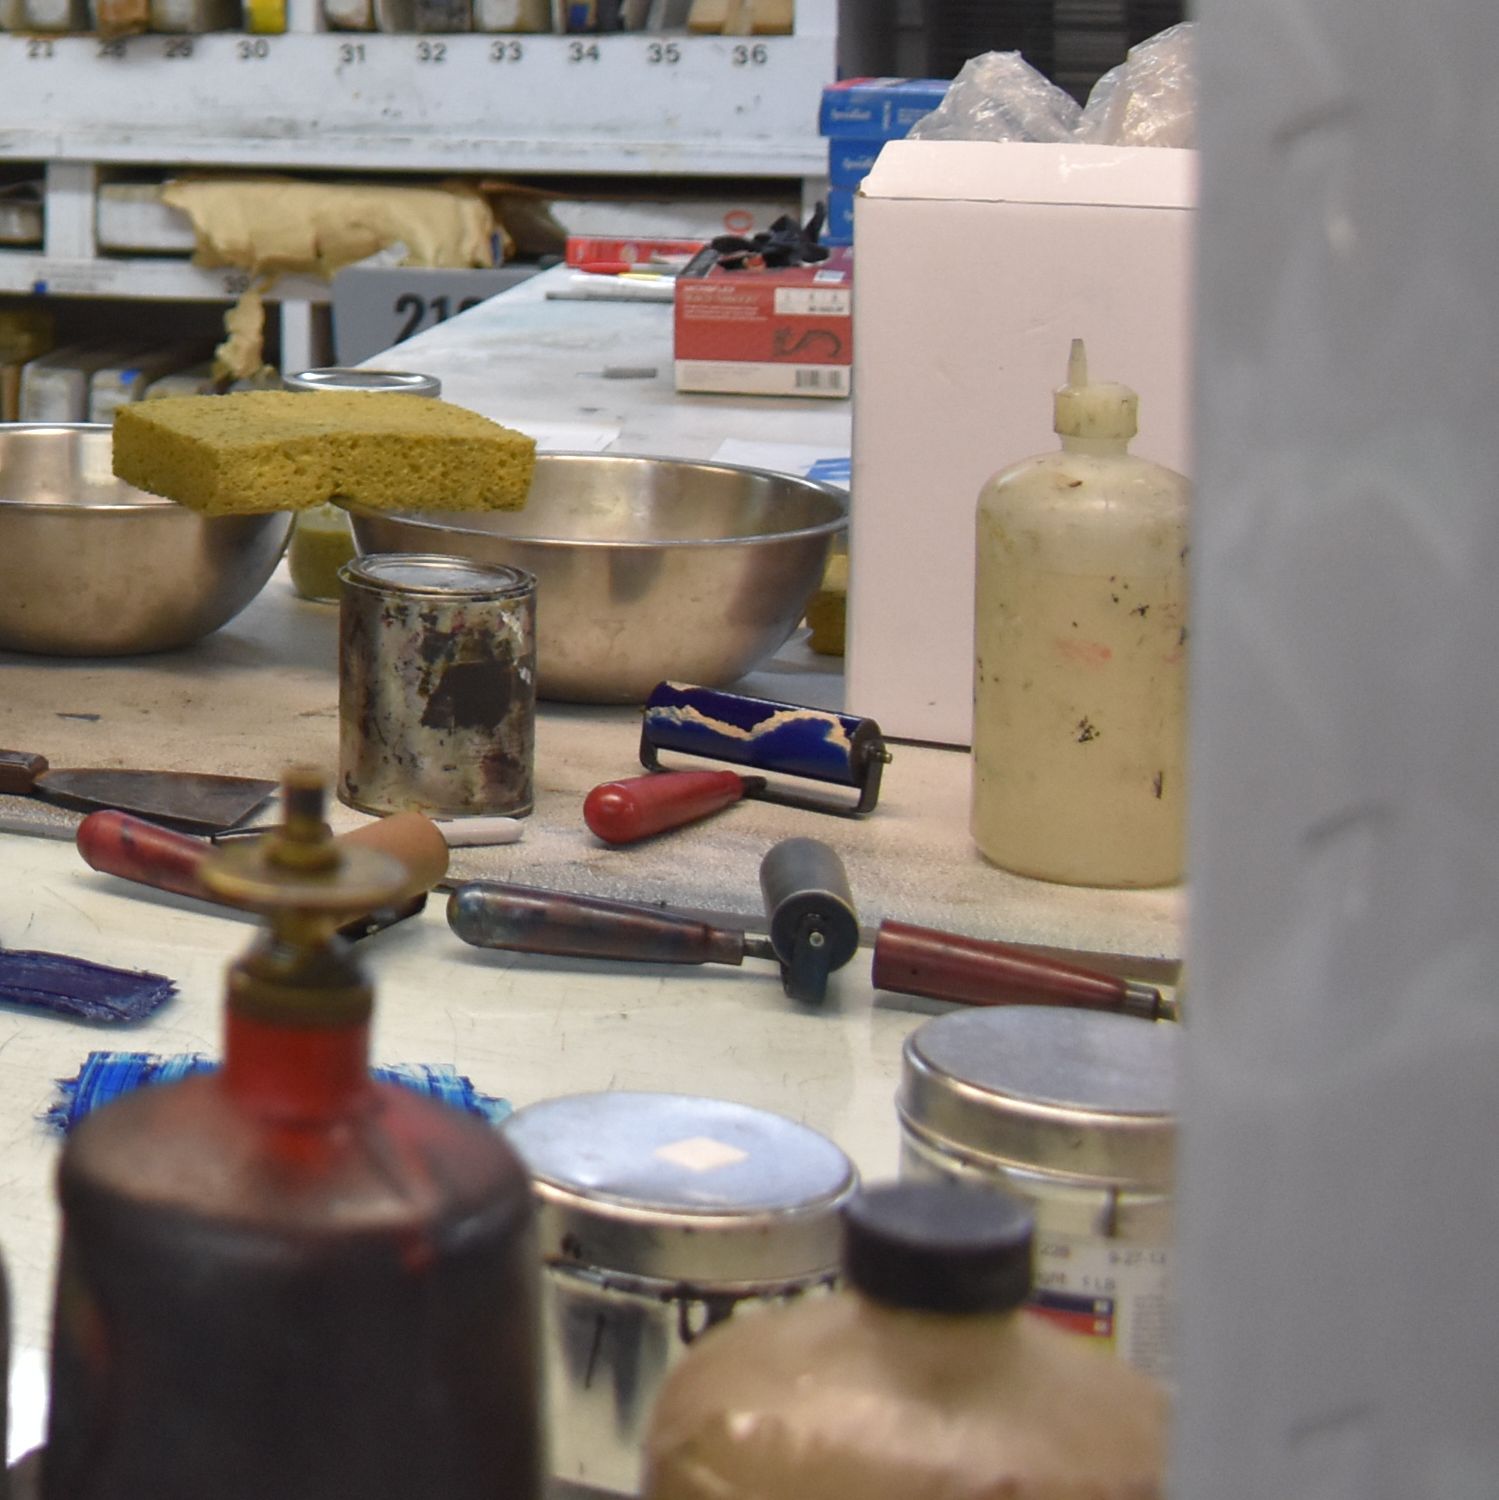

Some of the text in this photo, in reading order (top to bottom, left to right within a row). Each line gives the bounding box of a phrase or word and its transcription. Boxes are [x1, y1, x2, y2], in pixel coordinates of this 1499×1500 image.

[236, 37, 271, 61] 30
[339, 42, 367, 65] 31
[415, 41, 448, 63] 32
[489, 40, 524, 63] 33
[568, 41, 601, 63] 34
[647, 41, 682, 64] 35
[732, 43, 769, 67] 36
